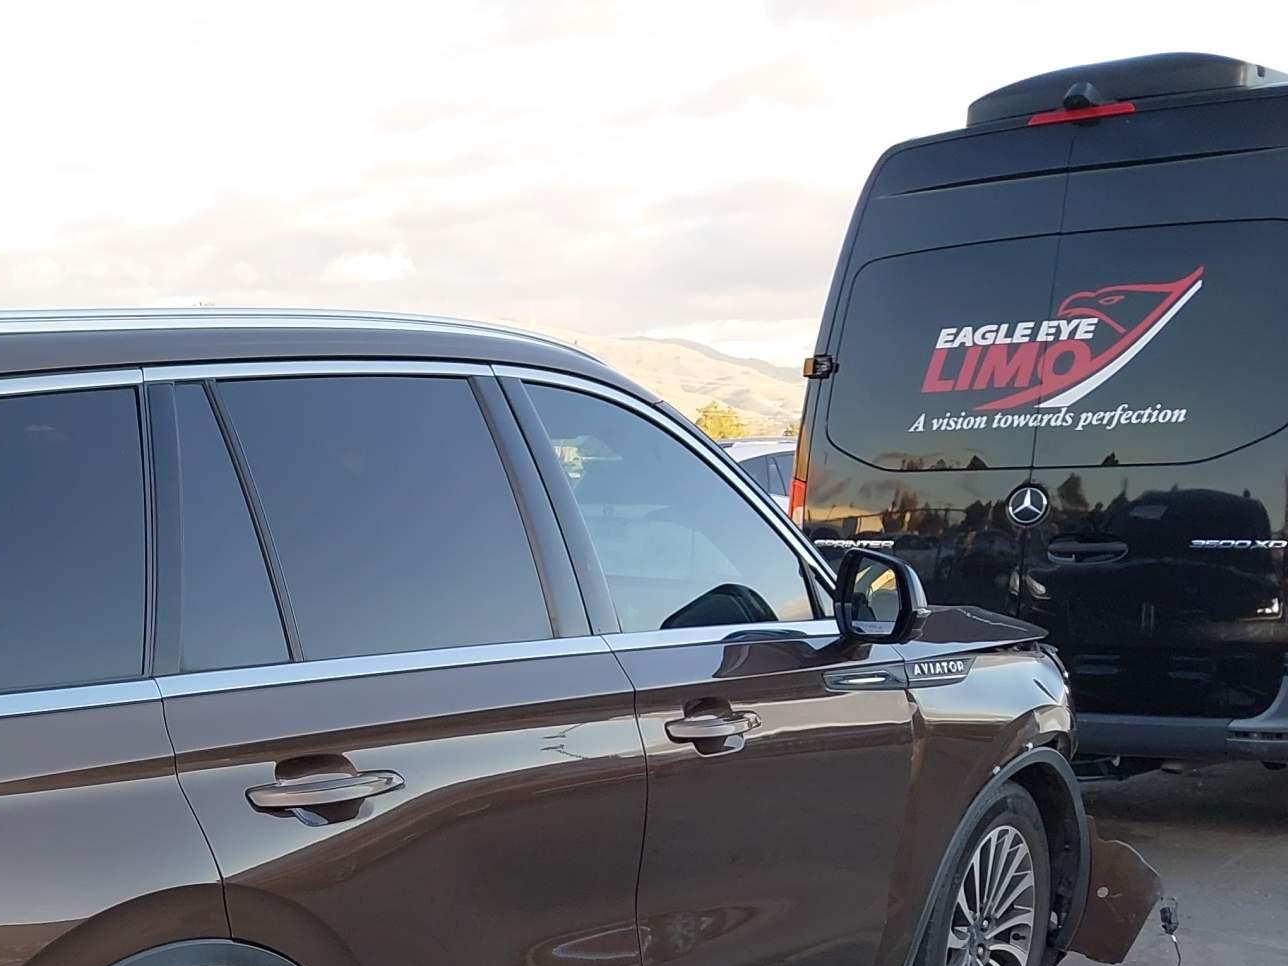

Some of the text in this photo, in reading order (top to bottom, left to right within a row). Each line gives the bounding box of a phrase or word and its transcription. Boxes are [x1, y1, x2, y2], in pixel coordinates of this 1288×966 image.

[935, 318, 1099, 349] EAGLE EYE
[921, 339, 1094, 393] LIMO
[908, 403, 1187, 432] A vision towards perfection
[813, 539, 895, 549] SPRINTER
[914, 661, 964, 676] AVIATOR
